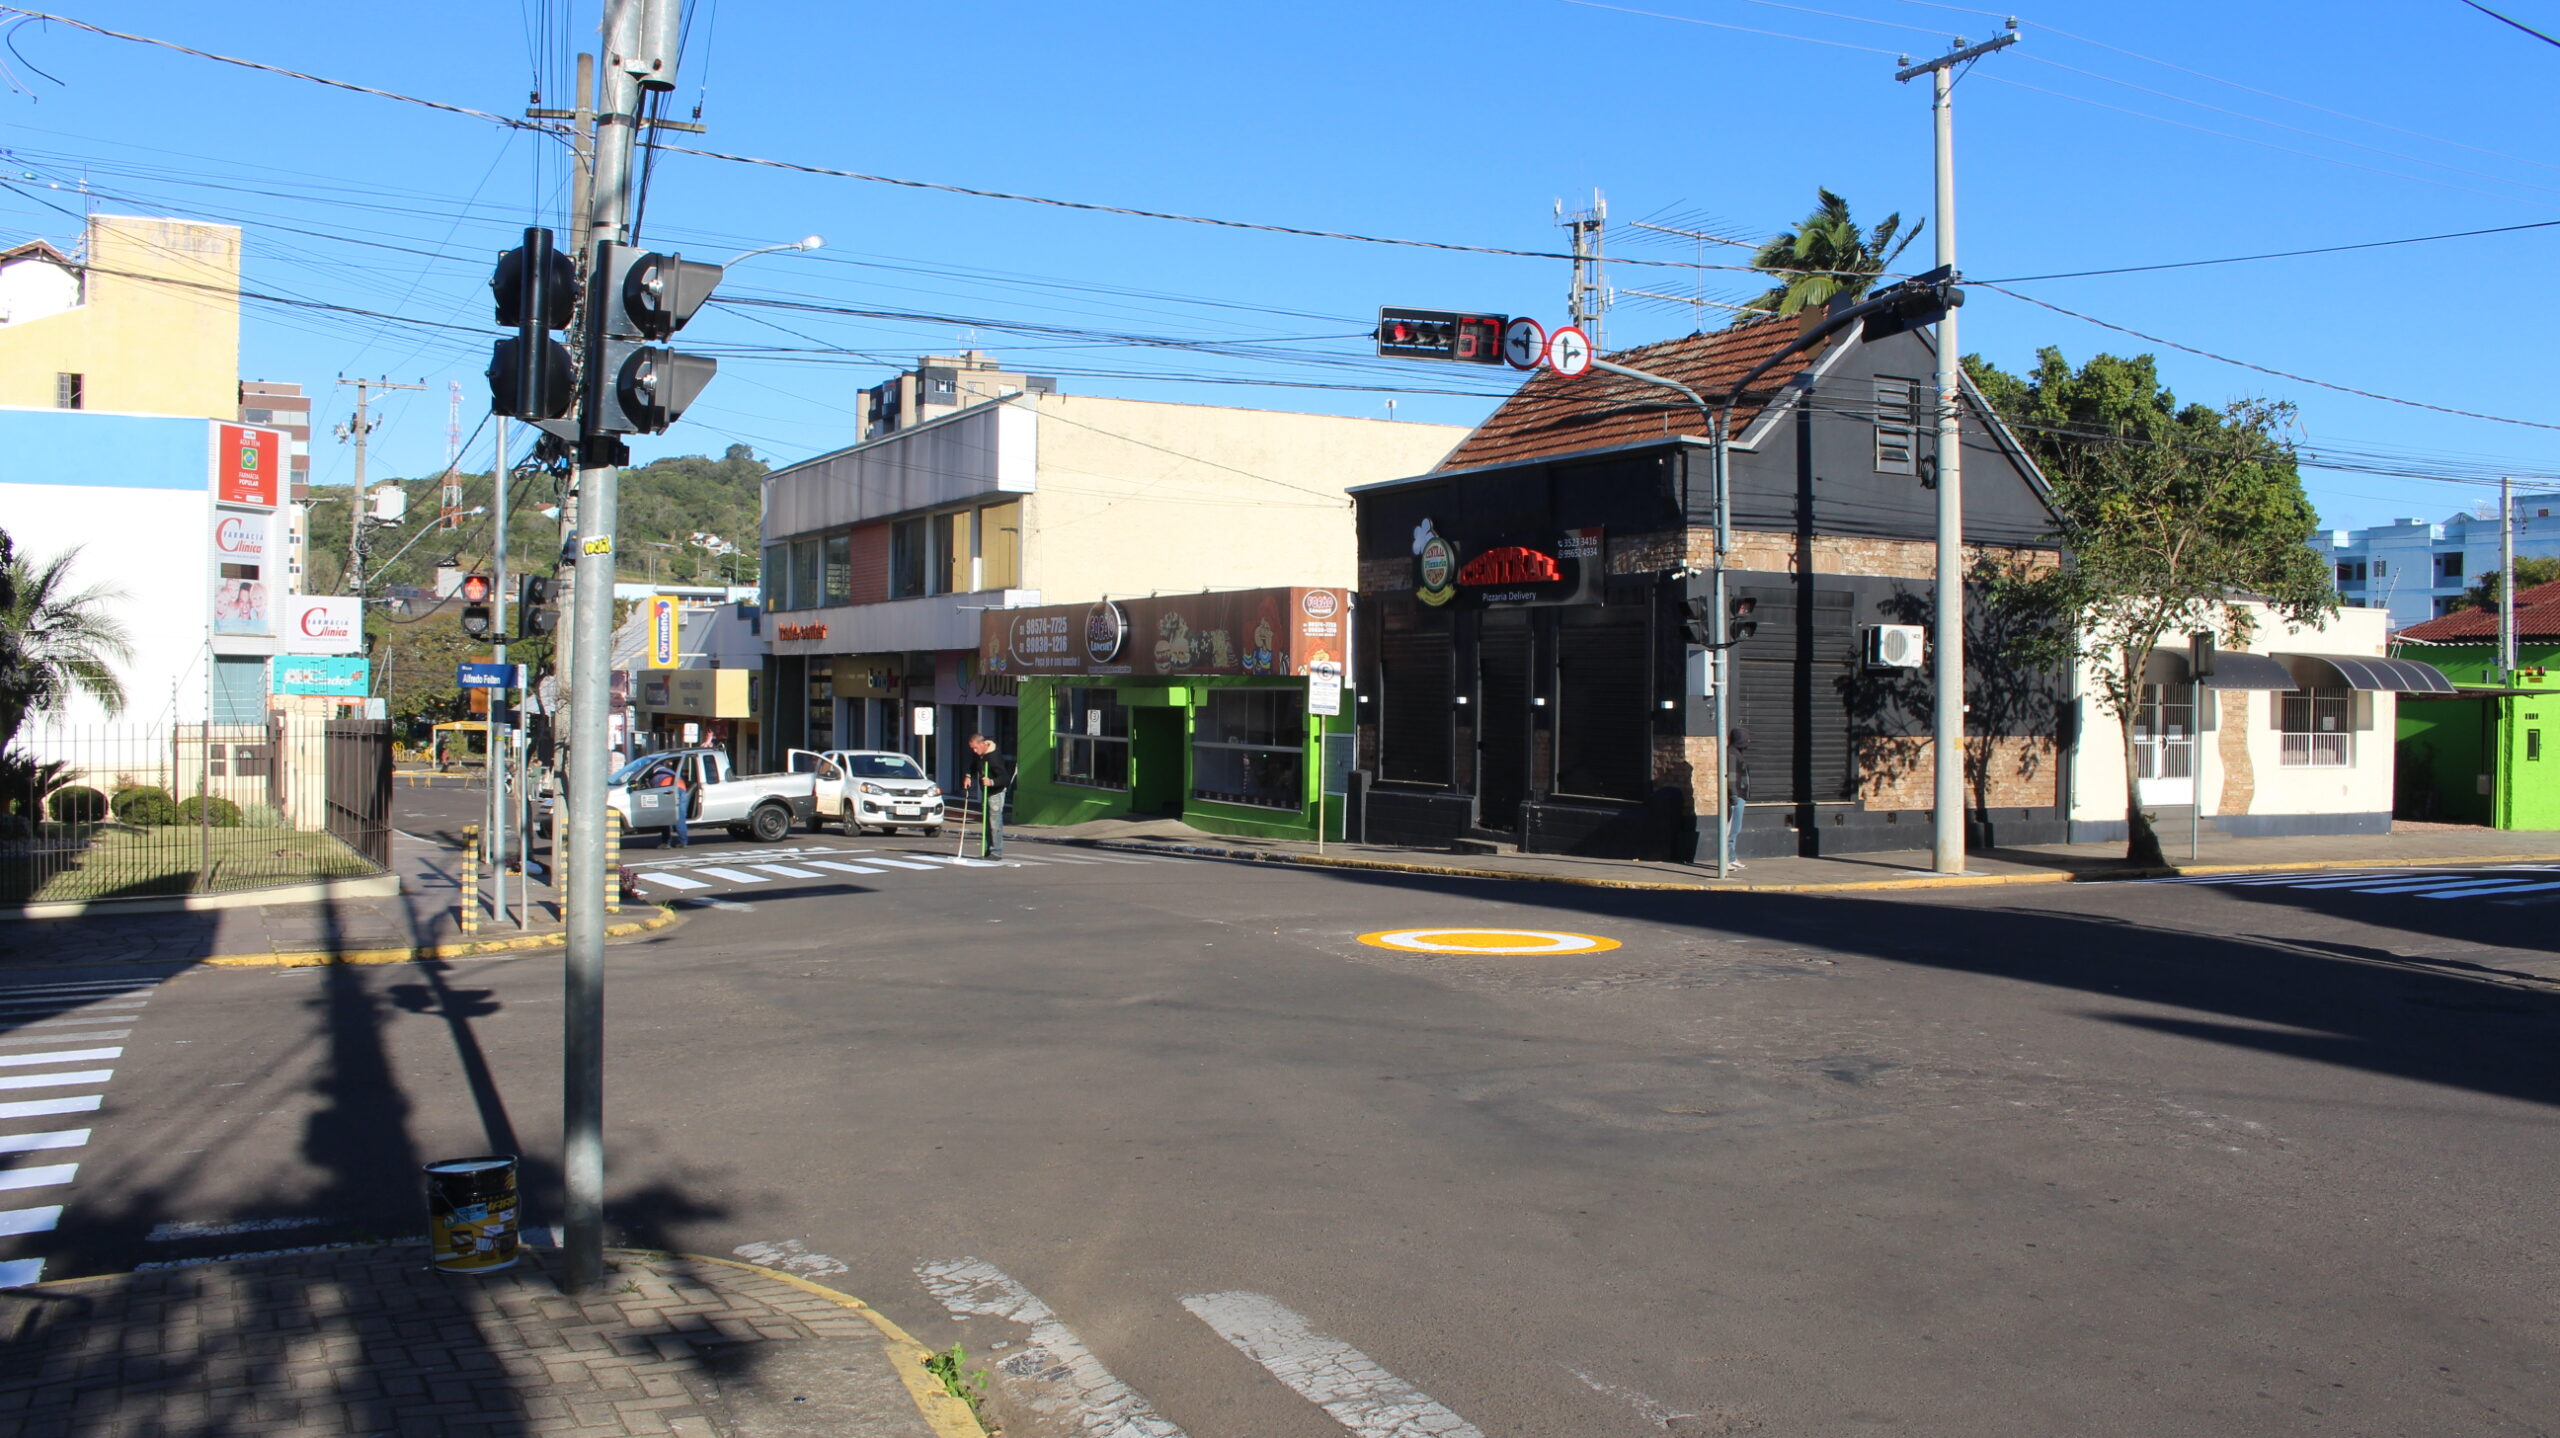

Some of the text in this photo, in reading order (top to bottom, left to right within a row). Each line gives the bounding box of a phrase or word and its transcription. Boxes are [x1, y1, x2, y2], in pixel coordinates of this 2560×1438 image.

[1564, 536, 1597, 547] 3523 3416
[1460, 546, 1564, 586] CENTRAL
[1482, 591, 1537, 601] Pizzaria Delivery
[462, 673, 482, 684] Alfredo
